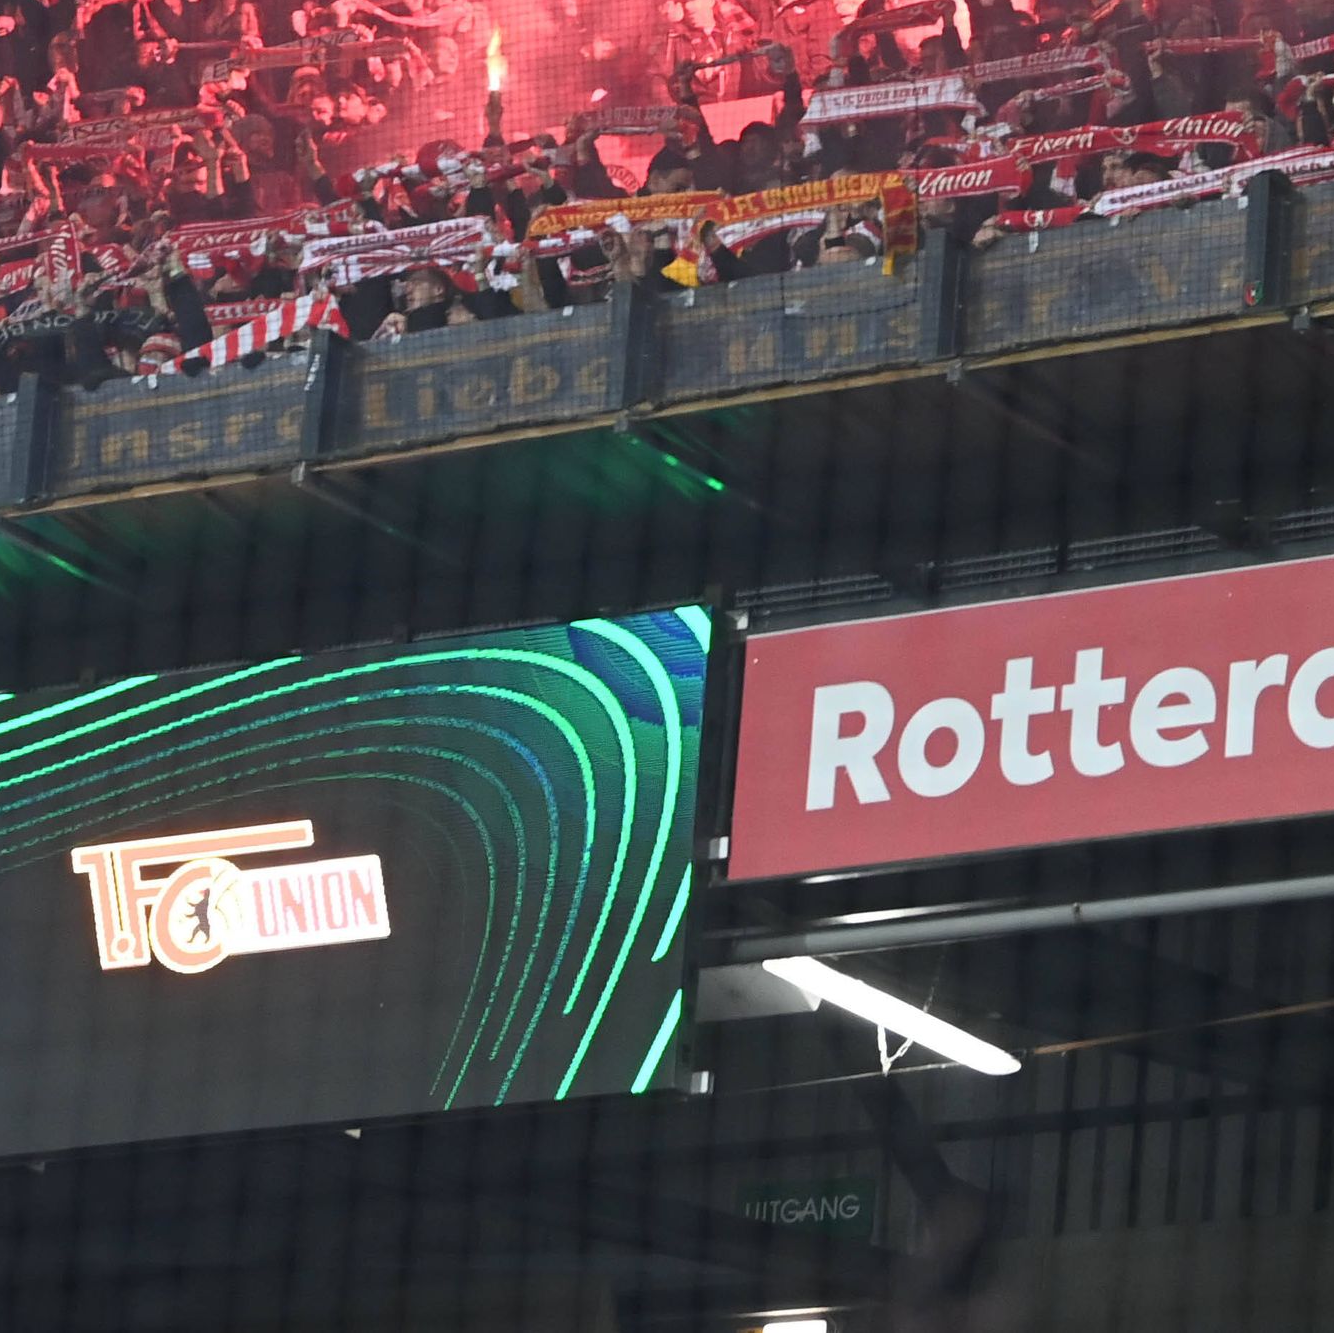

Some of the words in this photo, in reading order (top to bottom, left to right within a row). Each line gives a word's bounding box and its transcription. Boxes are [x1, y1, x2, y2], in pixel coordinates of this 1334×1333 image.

[1009, 130, 1094, 156] Eisern
[1163, 114, 1245, 139] Union
[765, 179, 831, 209] UNION
[919, 168, 993, 196] Union
[251, 868, 379, 938] UNION
